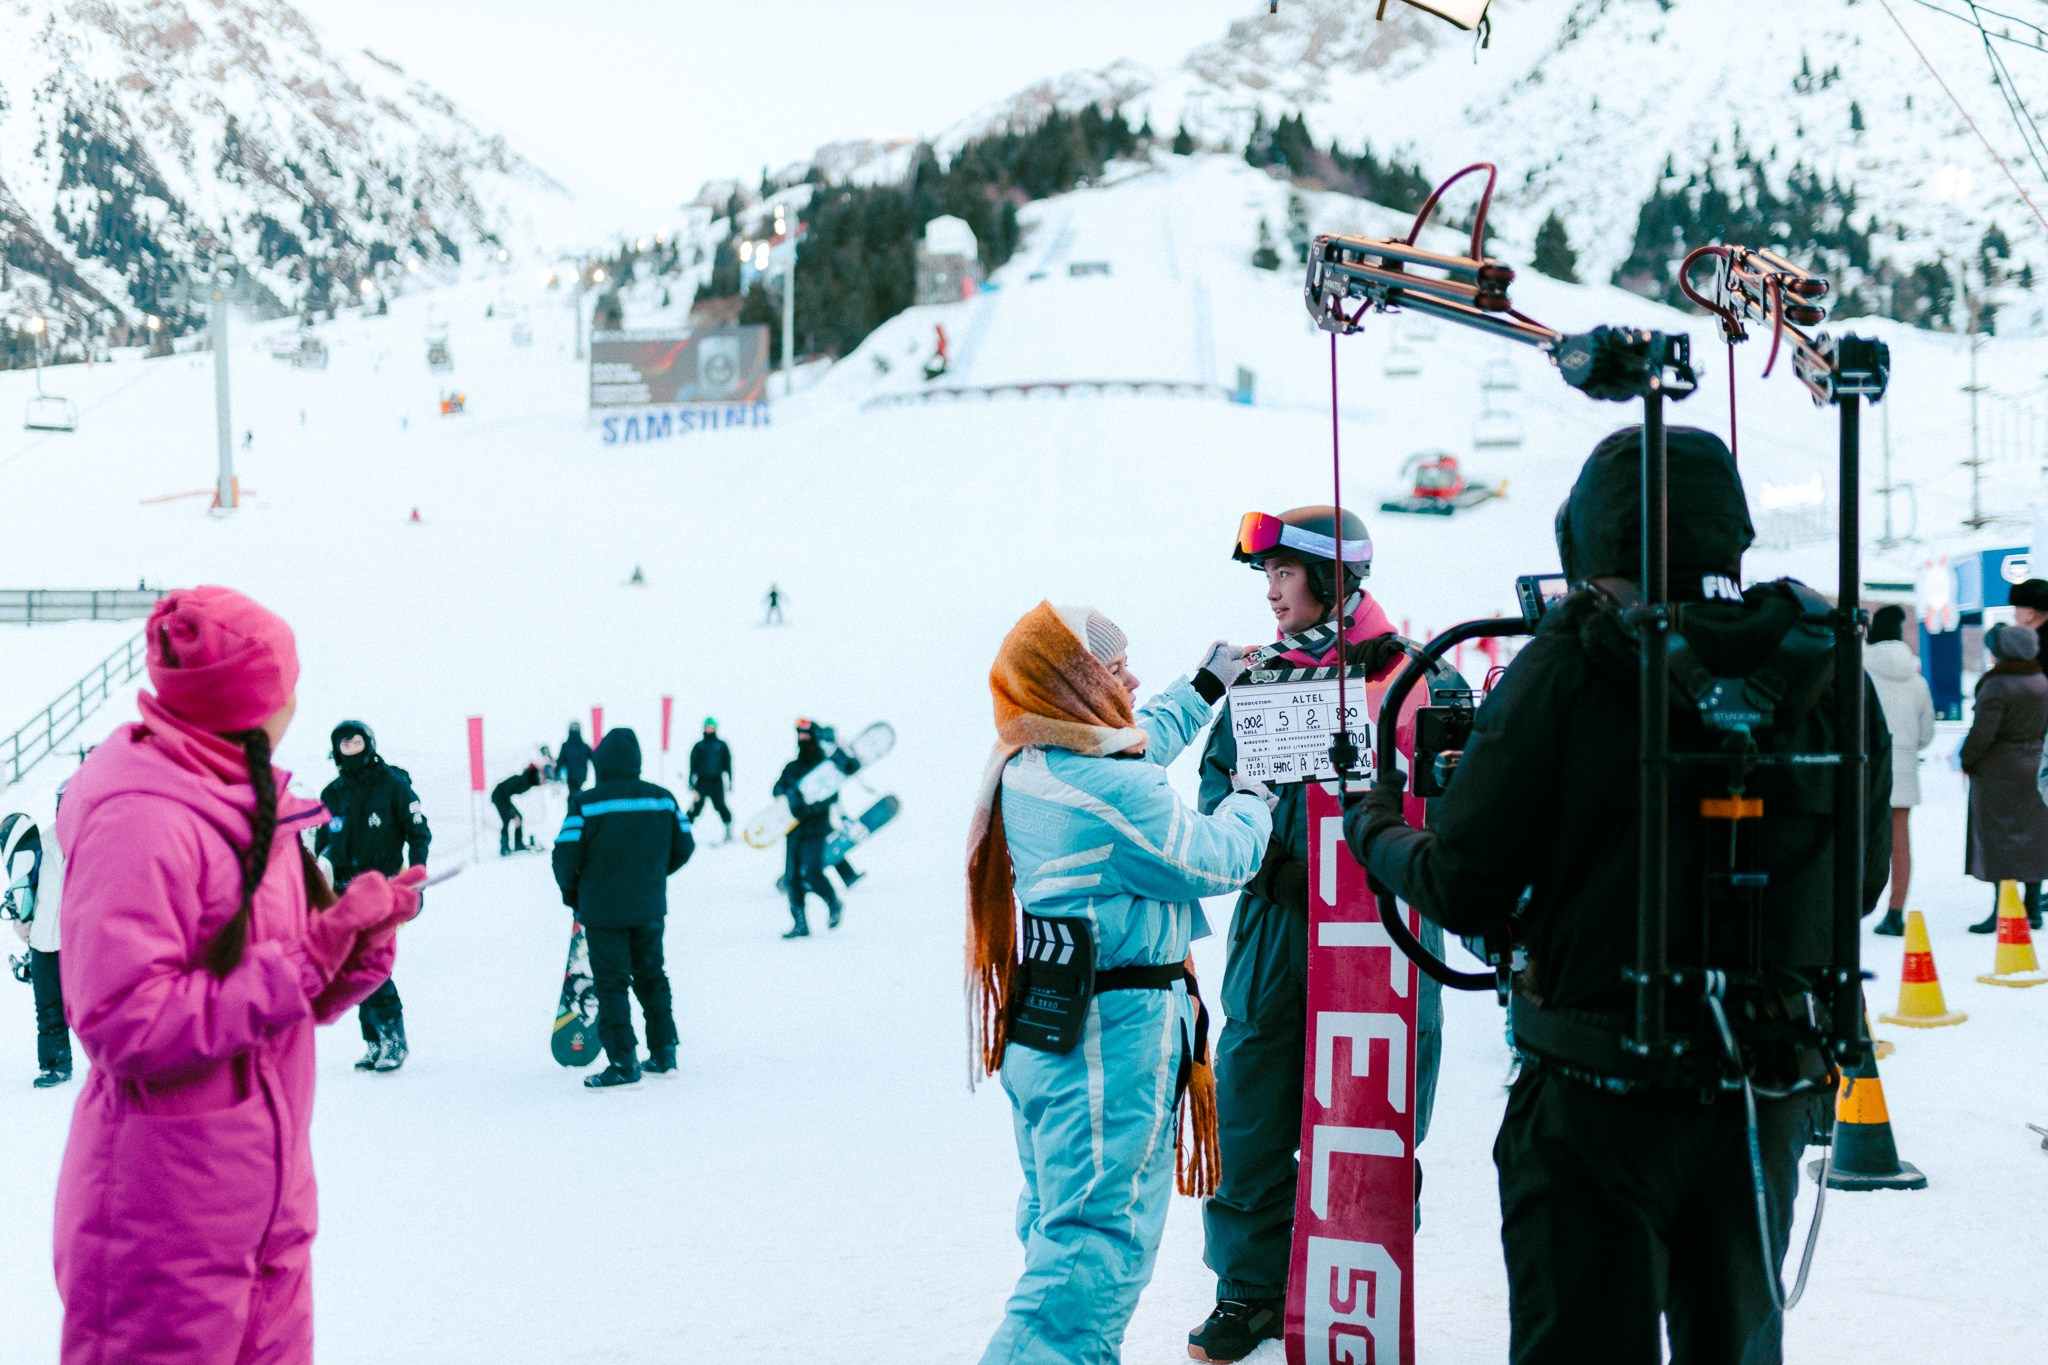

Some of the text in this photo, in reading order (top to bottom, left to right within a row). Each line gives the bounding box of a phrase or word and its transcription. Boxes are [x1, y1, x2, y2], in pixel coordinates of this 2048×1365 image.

[1292, 694, 1324, 704] ALTEL
[1279, 711, 1289, 726] 5
[1306, 709, 1318, 726] 2
[1336, 708, 1358, 720] 800
[1301, 757, 1307, 771] A
[1314, 758, 1329, 770] 25
[1329, 1266, 1377, 1365] 5G
